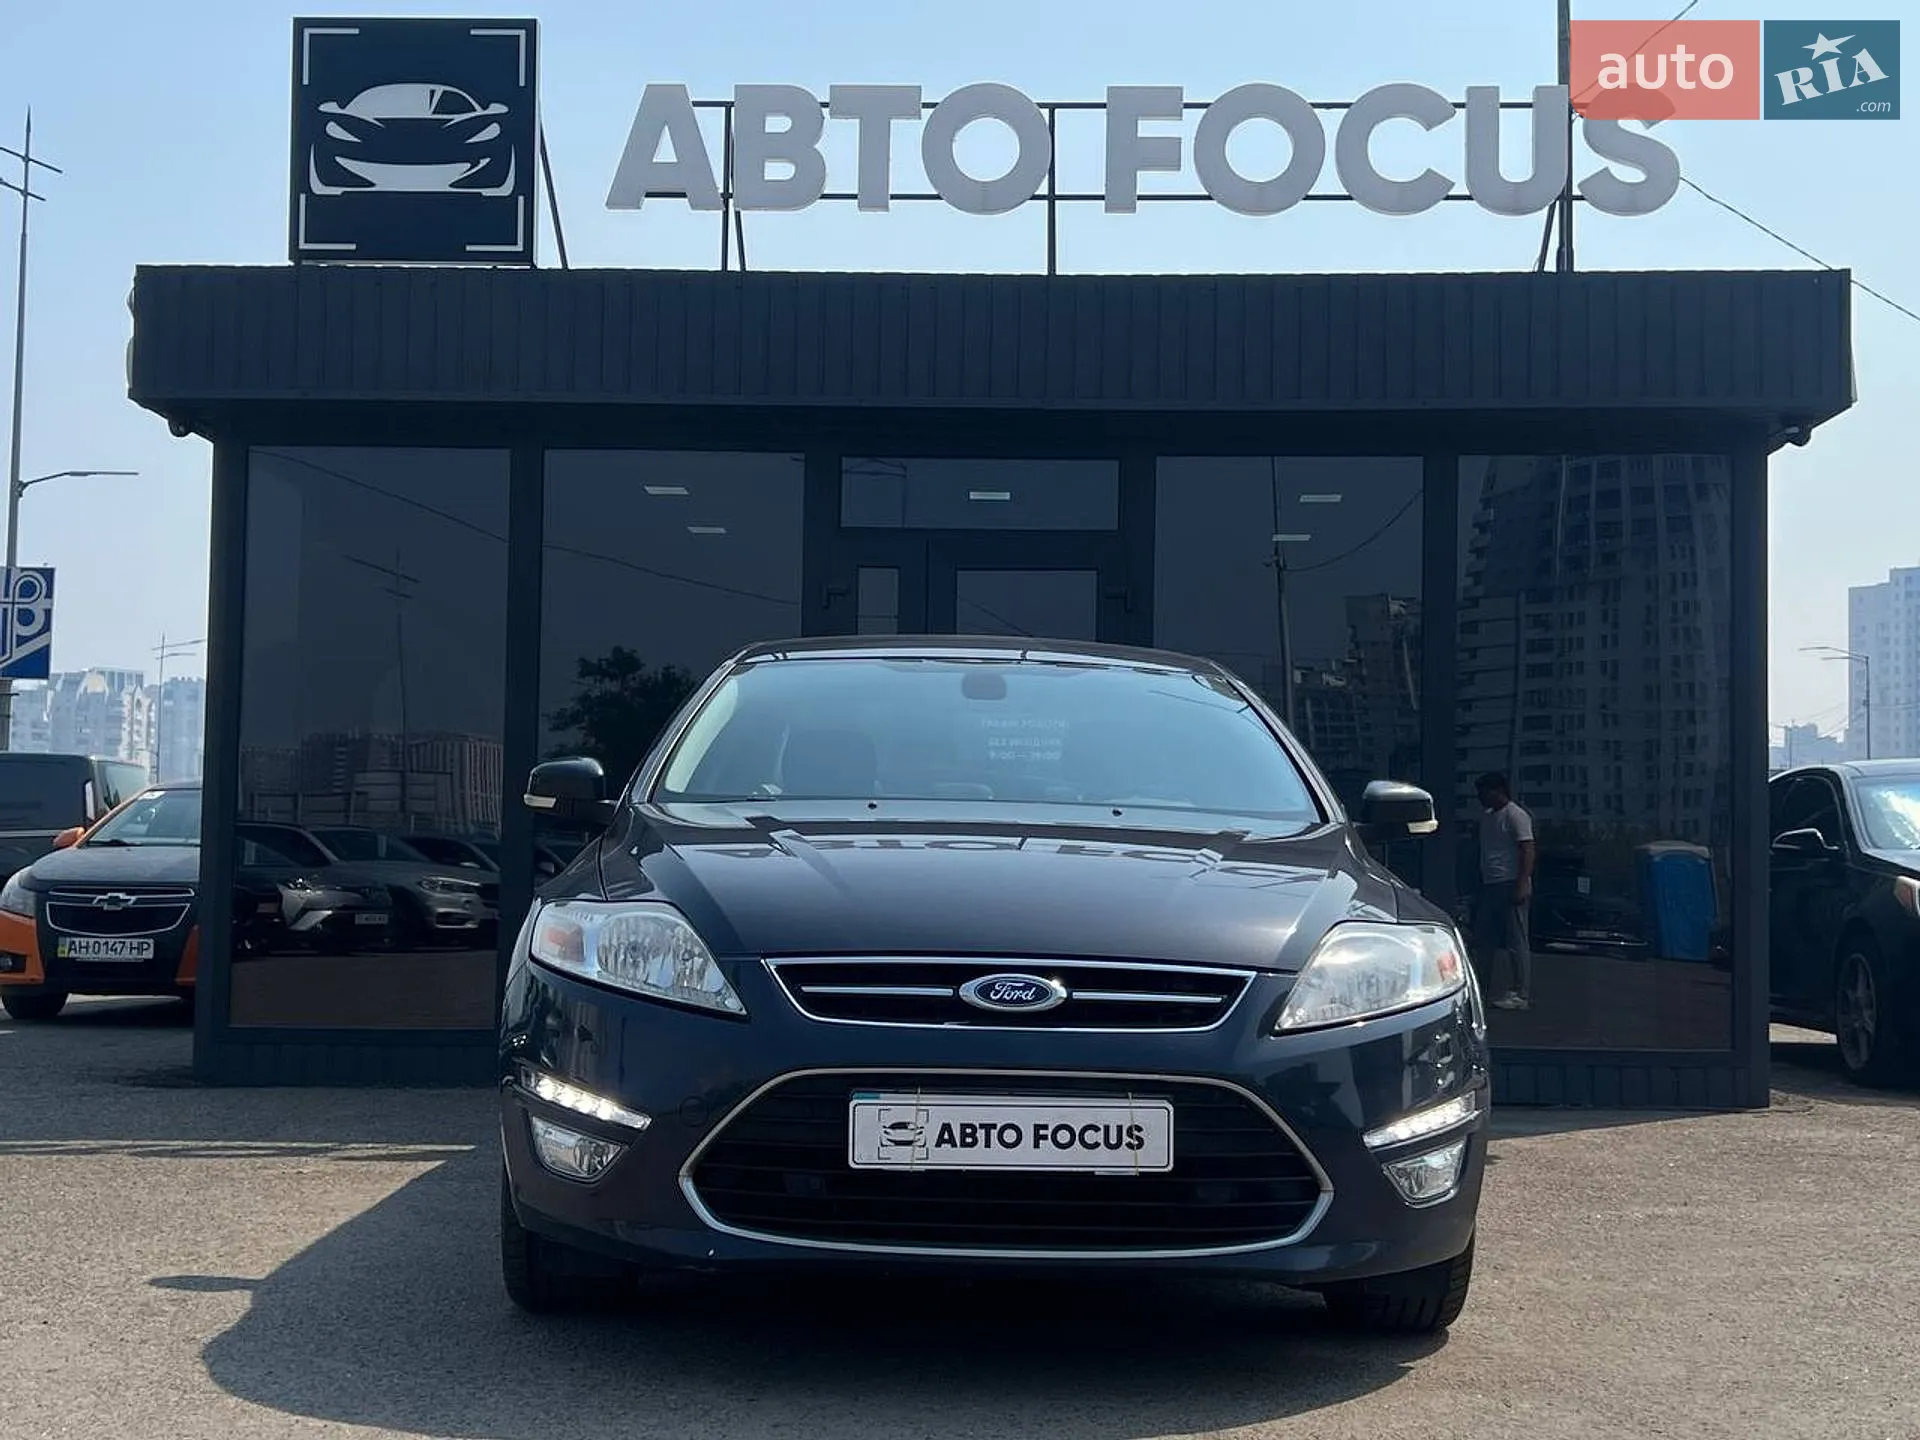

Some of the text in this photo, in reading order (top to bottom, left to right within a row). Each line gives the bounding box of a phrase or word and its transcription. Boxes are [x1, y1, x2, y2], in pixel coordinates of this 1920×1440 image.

[605, 83, 1681, 216] АВТО FOCUS
[92, 940, 126, 954] 0147
[129, 941, 152, 955] HP
[989, 981, 1037, 1002] Ford
[934, 1122, 1145, 1151] АВТО FOCUS
